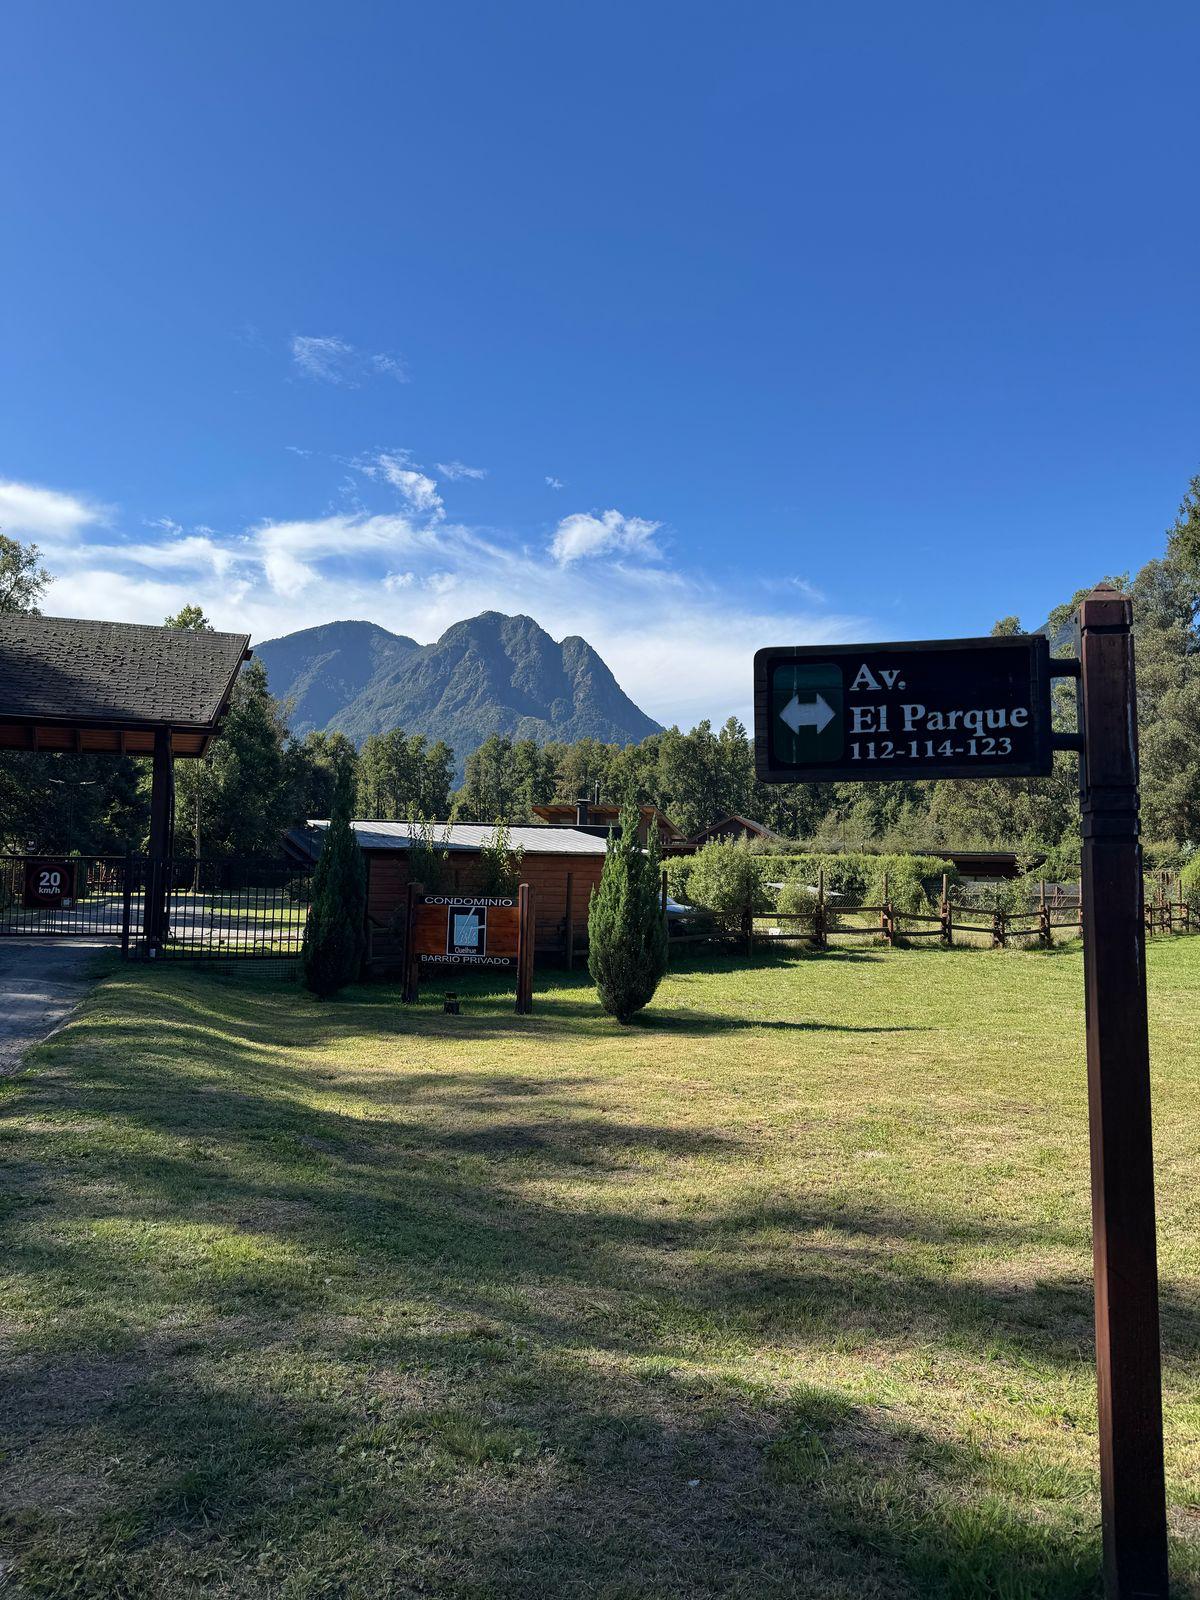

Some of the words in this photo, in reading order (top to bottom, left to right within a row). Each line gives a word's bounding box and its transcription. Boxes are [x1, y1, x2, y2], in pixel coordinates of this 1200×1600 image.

[849, 663, 906, 691] Av.
[849, 704, 890, 734] El
[900, 704, 1028, 737] Parque
[850, 737, 1012, 759] 112-114-123
[39, 872, 60, 886] 20
[38, 886, 60, 894] km/h
[424, 896, 513, 906] CONDOMINIO
[421, 955, 460, 963] BARRIO
[462, 956, 510, 964] PRIVADO
